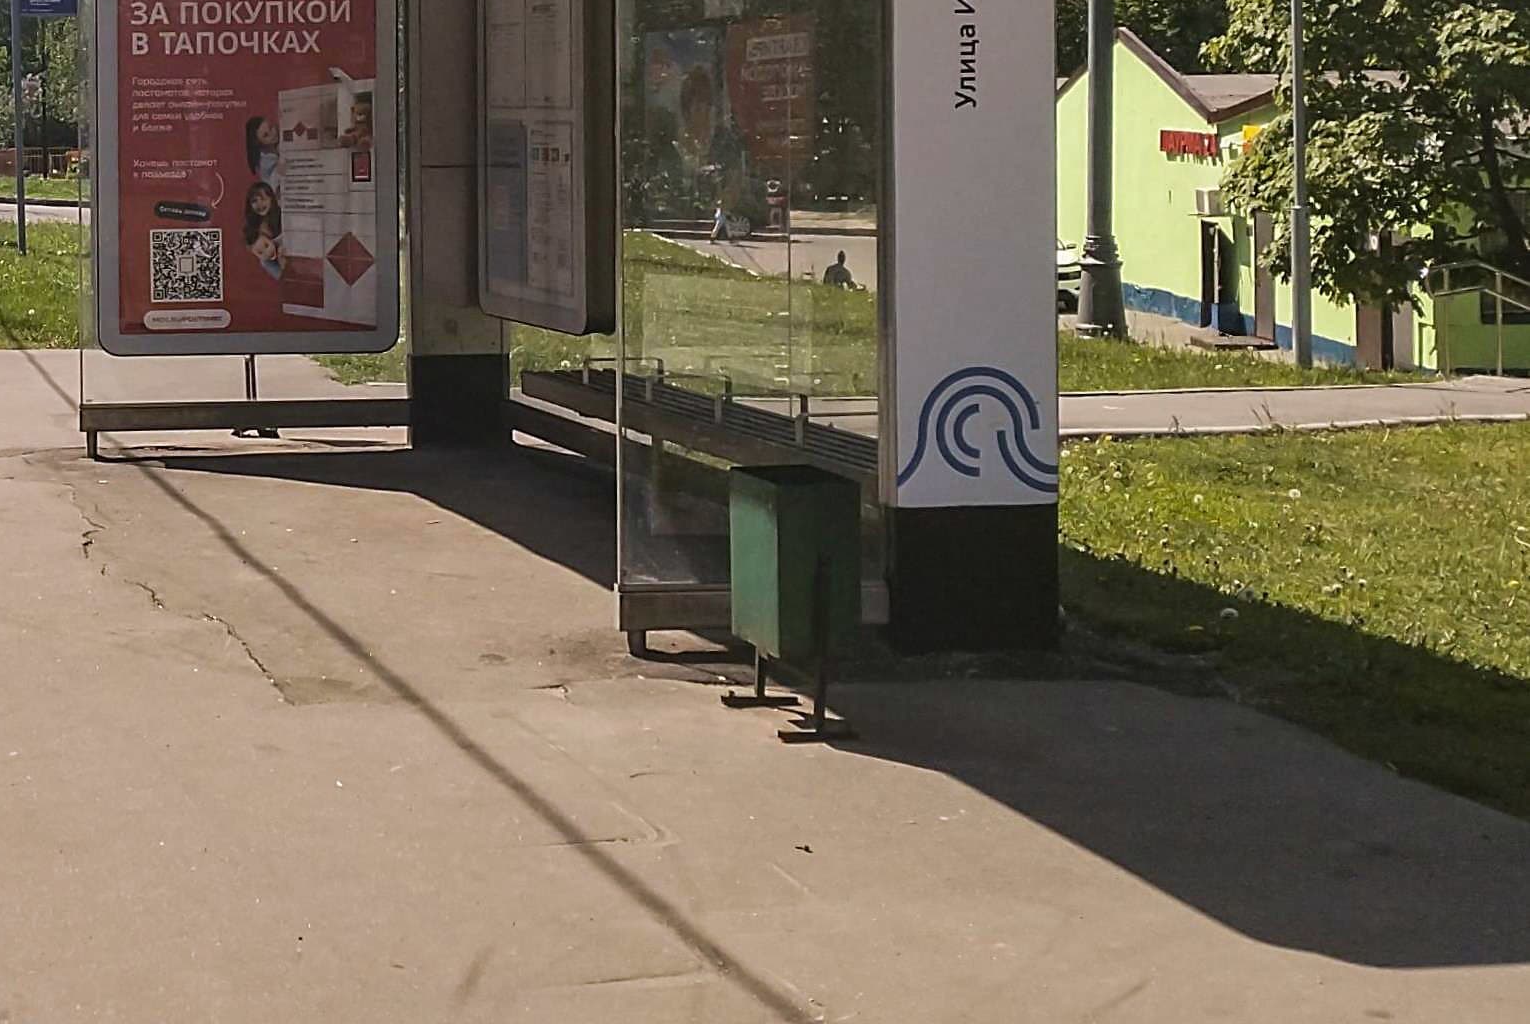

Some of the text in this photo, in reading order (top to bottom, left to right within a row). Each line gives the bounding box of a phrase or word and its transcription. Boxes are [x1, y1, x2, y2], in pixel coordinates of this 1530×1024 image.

[130, 1, 170, 25] ЗА
[132, 30, 321, 56] В ТАПОЧКАХ
[955, 24, 980, 110] Улица
